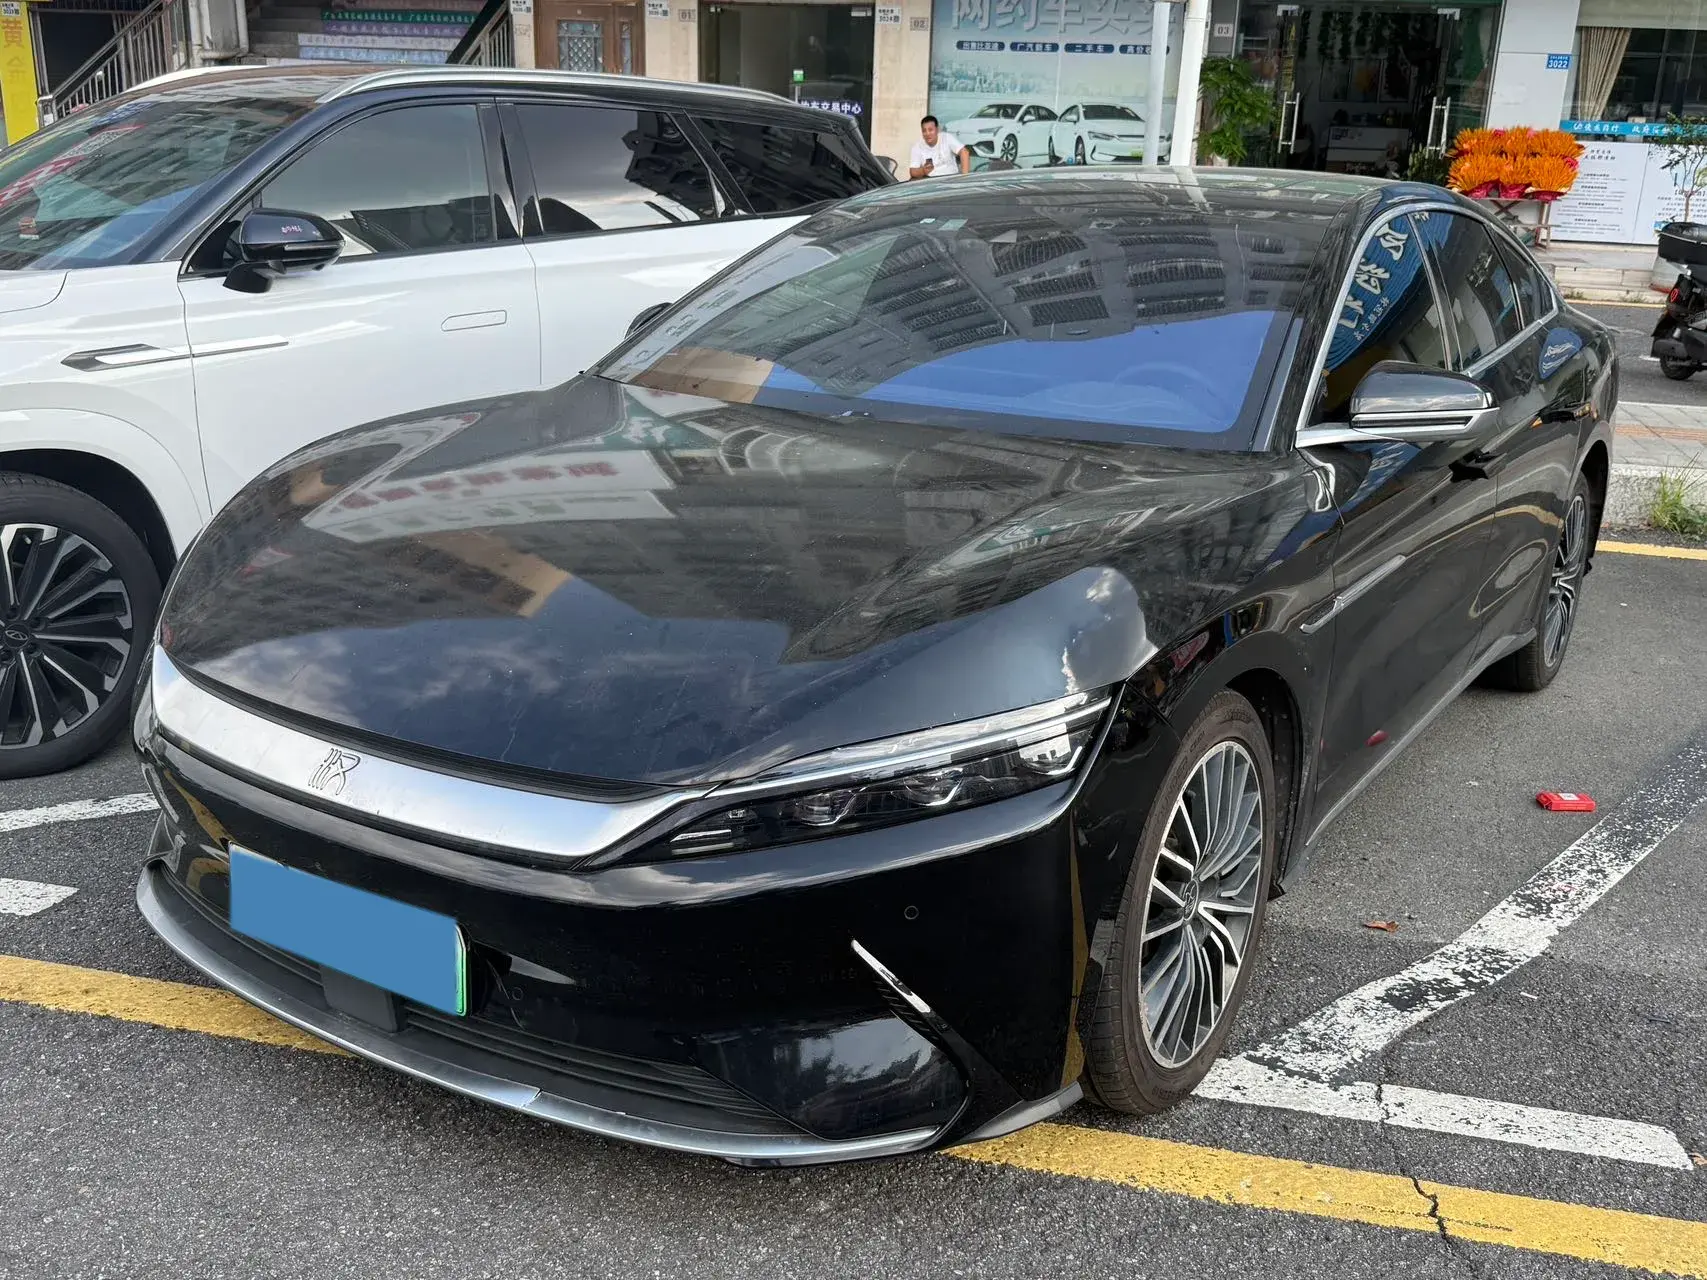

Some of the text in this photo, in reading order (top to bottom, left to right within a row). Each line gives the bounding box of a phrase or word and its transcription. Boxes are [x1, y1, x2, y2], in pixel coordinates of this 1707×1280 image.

[1075, 45, 1105, 53] 二手车
[1126, 46, 1152, 55] 高价收
[1548, 60, 1568, 68] 3022
